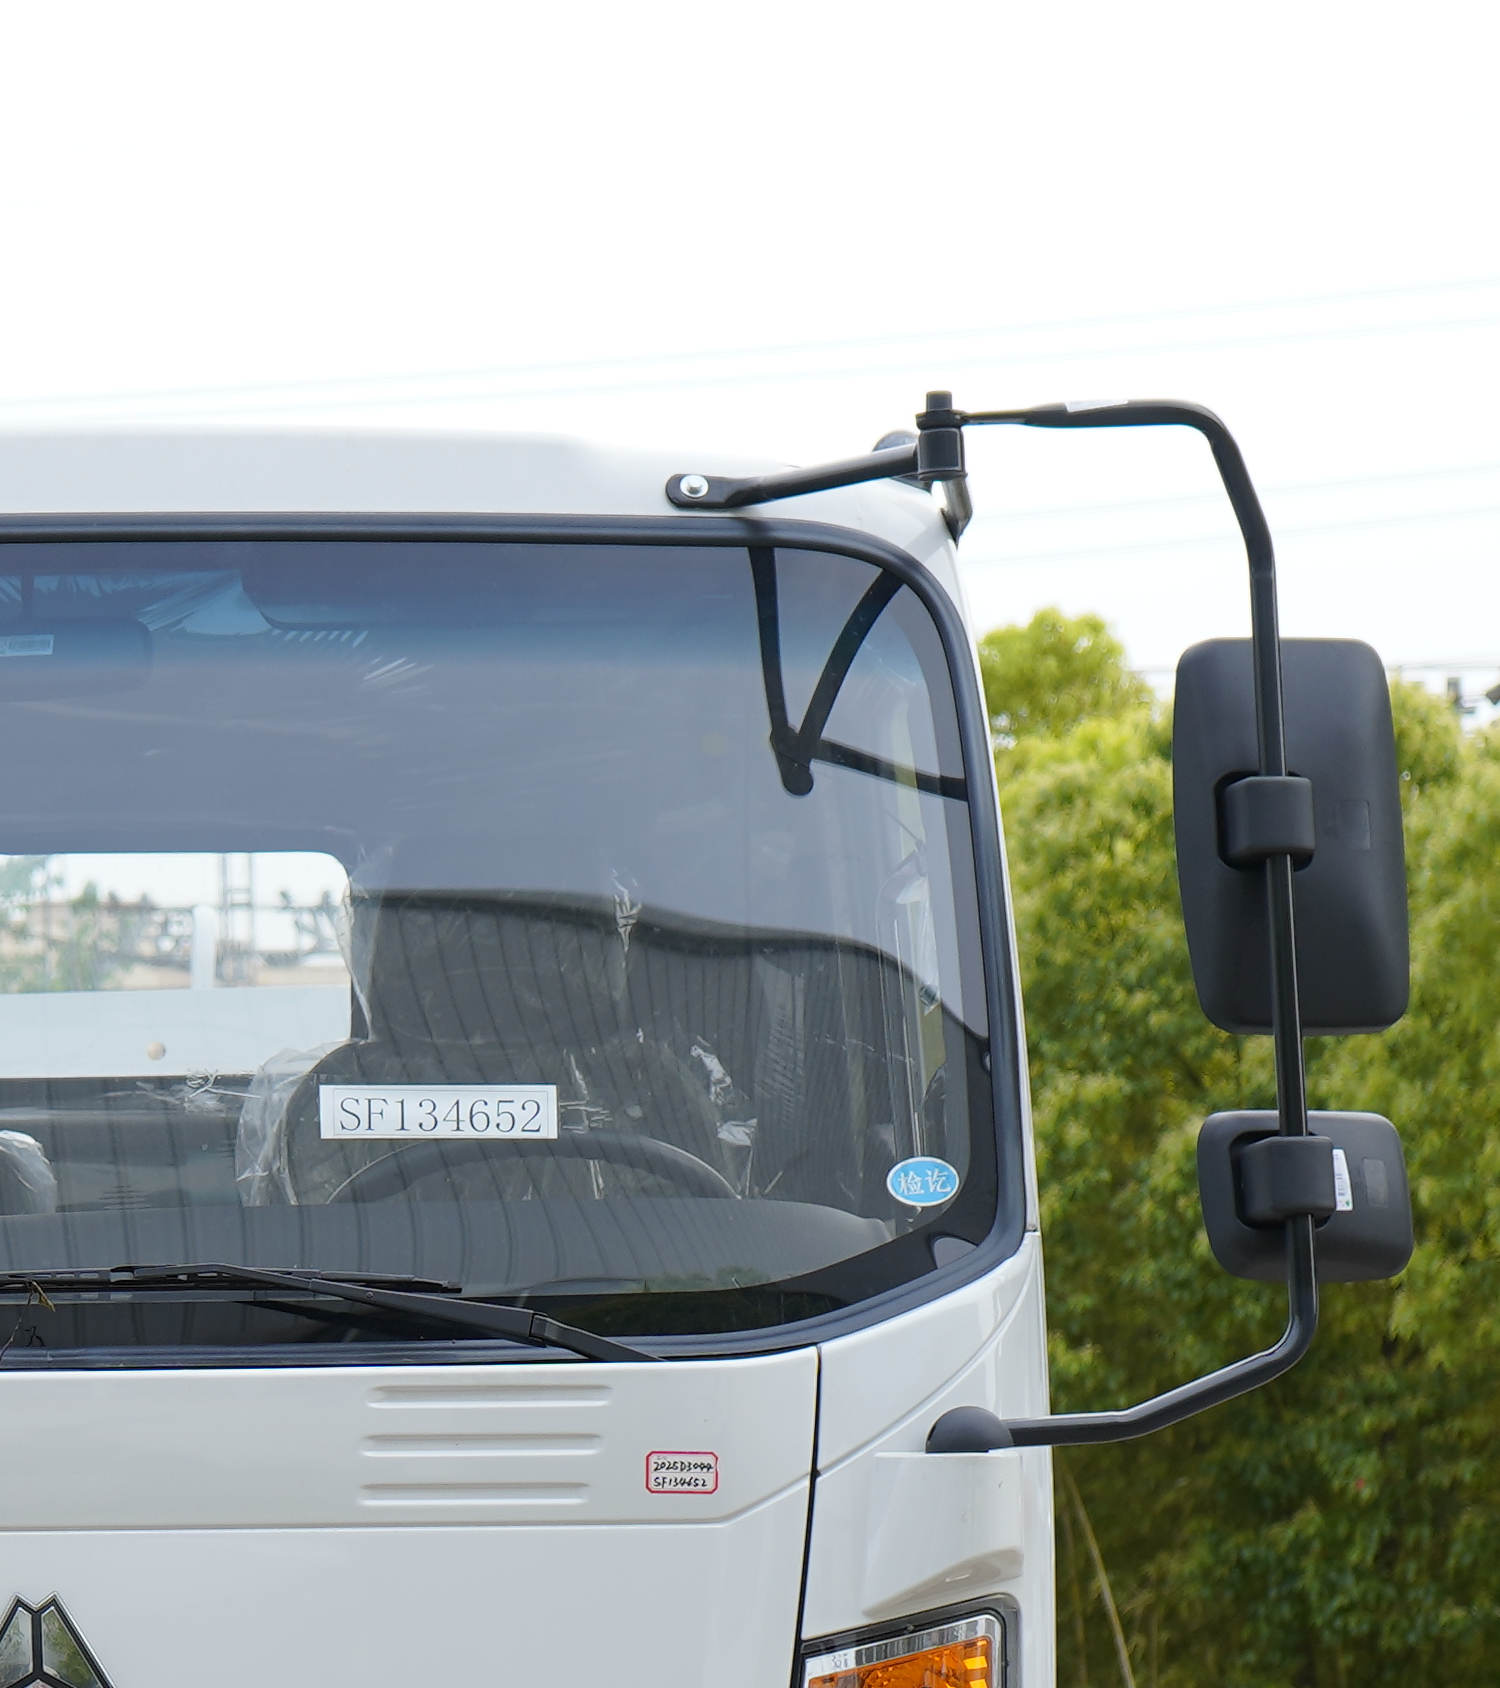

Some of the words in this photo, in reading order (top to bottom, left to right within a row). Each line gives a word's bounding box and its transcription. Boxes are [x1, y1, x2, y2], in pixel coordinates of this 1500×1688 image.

[339, 1097, 542, 1133] SF134652
[898, 1168, 952, 1195] 检讫
[653, 1477, 708, 1489] SF134652
